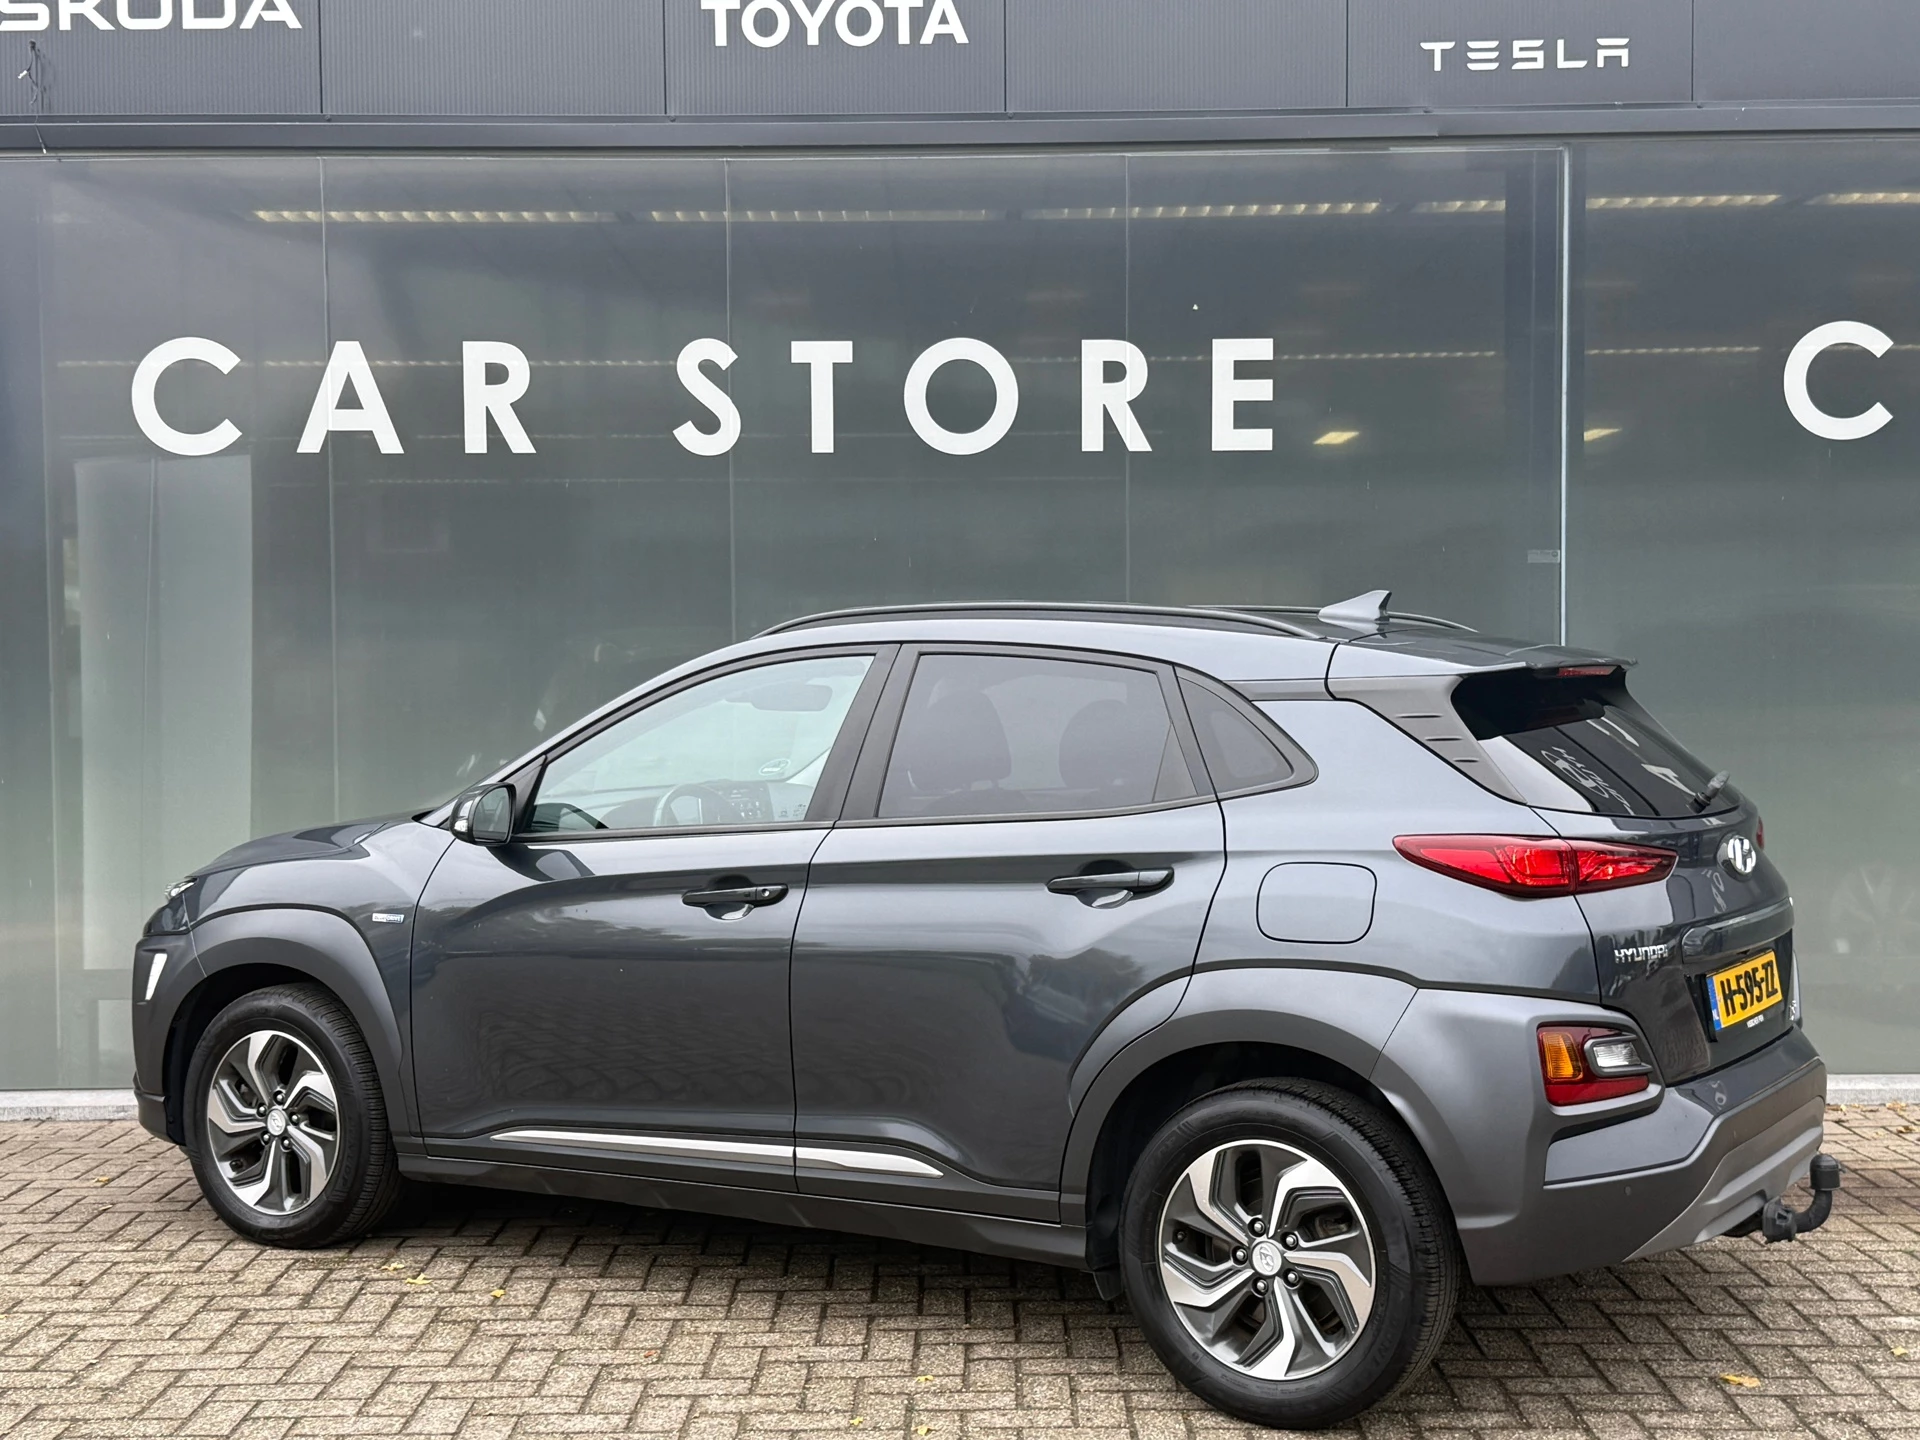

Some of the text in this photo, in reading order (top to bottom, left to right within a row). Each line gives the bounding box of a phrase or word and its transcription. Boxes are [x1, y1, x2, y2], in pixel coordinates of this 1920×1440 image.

[701, 0, 968, 47] TOYOTA
[1421, 38, 1630, 72] TESLA
[132, 337, 1275, 455] CAR STORE
[1784, 321, 1894, 440] C
[1614, 943, 1669, 963] HYUNDAI
[1720, 959, 1779, 1018] H-595-ZZ
